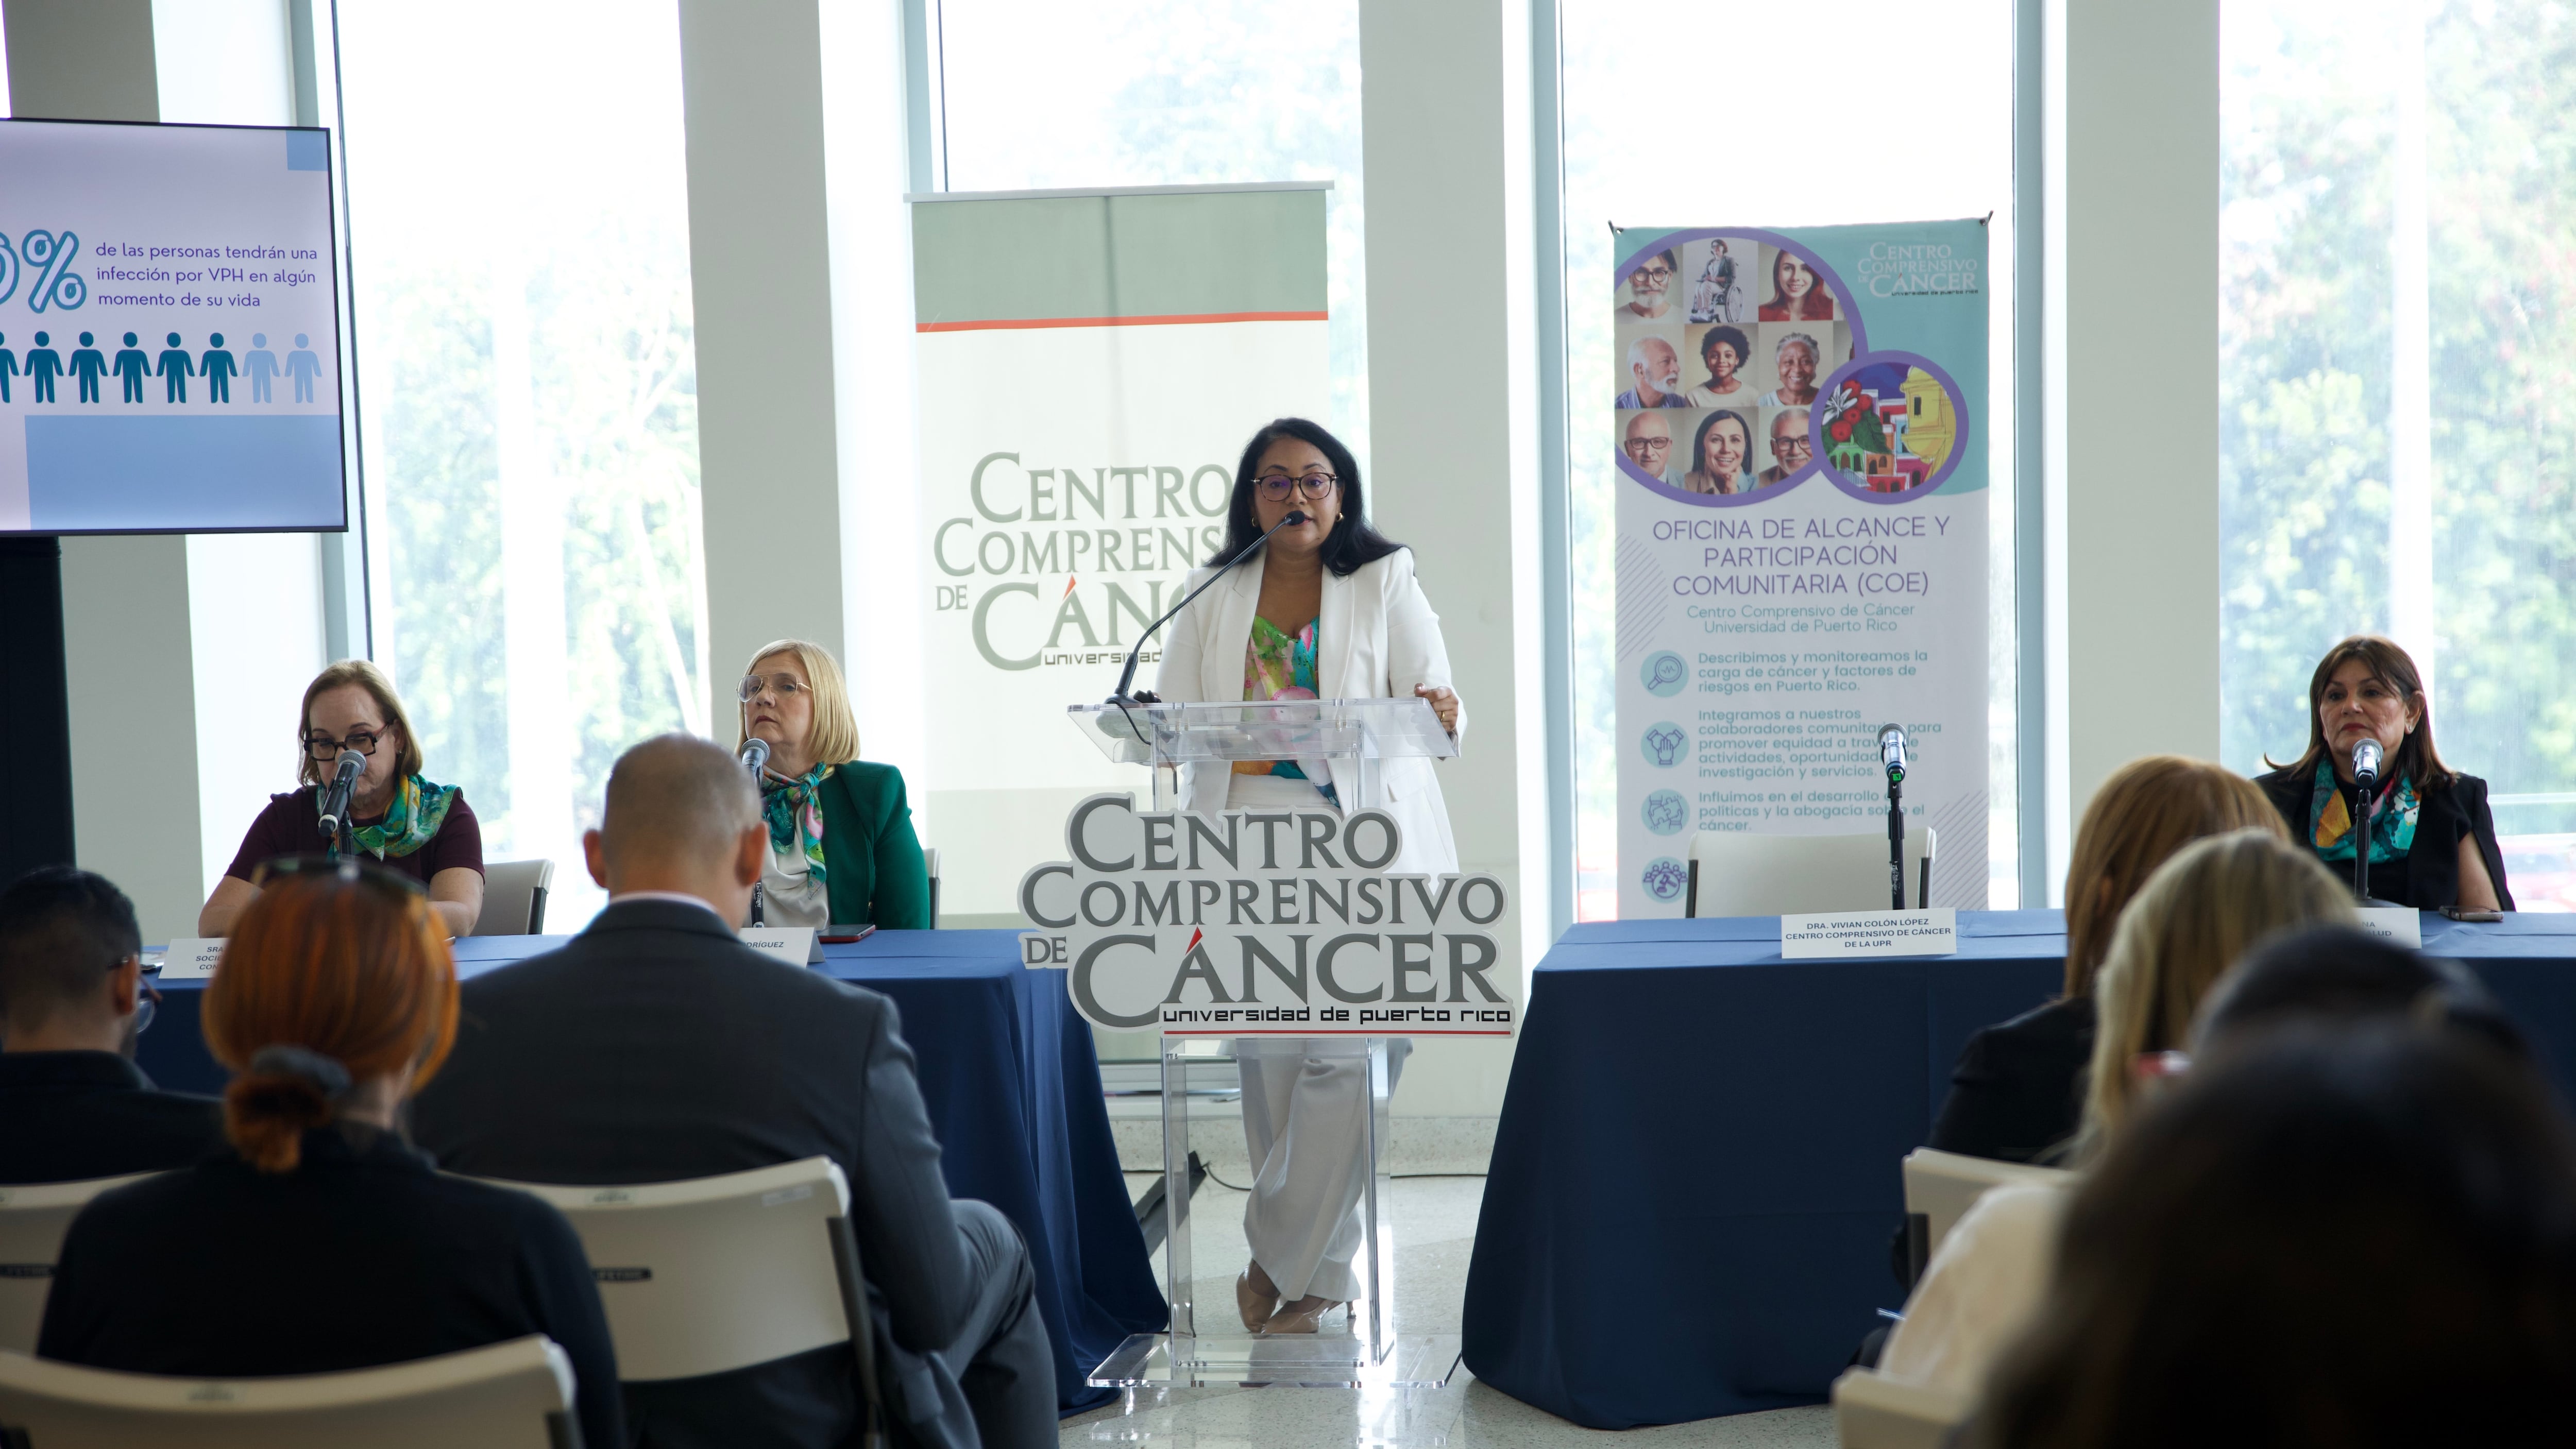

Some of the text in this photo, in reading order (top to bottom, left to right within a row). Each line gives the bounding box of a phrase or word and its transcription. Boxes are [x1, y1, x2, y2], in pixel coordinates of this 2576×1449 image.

[96, 242, 317, 260] de las personas tendrán una
[1870, 242, 1951, 261] CENTRO
[1858, 259, 1977, 274] COMPRENSIVO
[97, 266, 315, 286] infección por VPH en algún
[1869, 272, 1976, 297] CÁNCER
[99, 293, 260, 306] momento de su vida
[970, 451, 1233, 523] CENTRO
[1653, 516, 1950, 540] OFICINA DE ALCANCE Y
[934, 517, 1221, 576] COMPRENS
[1705, 540, 1896, 567] PARTICIPACIÓN
[1673, 571, 1928, 597] COMUNITARIA (COE)
[1687, 603, 1914, 620] Centro Comprensivo de Cáncer
[936, 574, 1187, 671] DE CÁN
[1705, 618, 1897, 633] Universidad de Puerto Rico
[1045, 649, 1162, 665] universiad
[1699, 650, 1927, 666] Describimos y monitoreamos la
[1699, 665, 1916, 681] carga de cáncer y factores de
[1699, 679, 1859, 695] riesgos en Puerto Rico.
[1699, 709, 1861, 724] Integramos a nuestros
[1699, 721, 1941, 737] colaboradores comunitar para
[1699, 740, 1768, 752] promover
[1773, 737, 1832, 752] equidad
[1837, 739, 1846, 747] a
[1851, 737, 1880, 747] trav
[1699, 752, 1785, 763] actividades,
[1790, 751, 1881, 765] oportunidad
[1699, 765, 1876, 780] investigación y servicios.
[1699, 791, 1764, 803] Influimos
[1768, 793, 1786, 802] en
[1790, 791, 1802, 802] el
[1807, 790, 1879, 801] desarrollo
[1699, 804, 1924, 820] políticas y la abogacía sobe el
[1699, 820, 1751, 831] cáncer.
[1070, 797, 1398, 873] CENTRO
[1022, 865, 1503, 928] COMPRENSIVO
[1025, 926, 1508, 1028] DE CÁNCER
[1164, 1007, 1510, 1025] universidad de puerto rico
